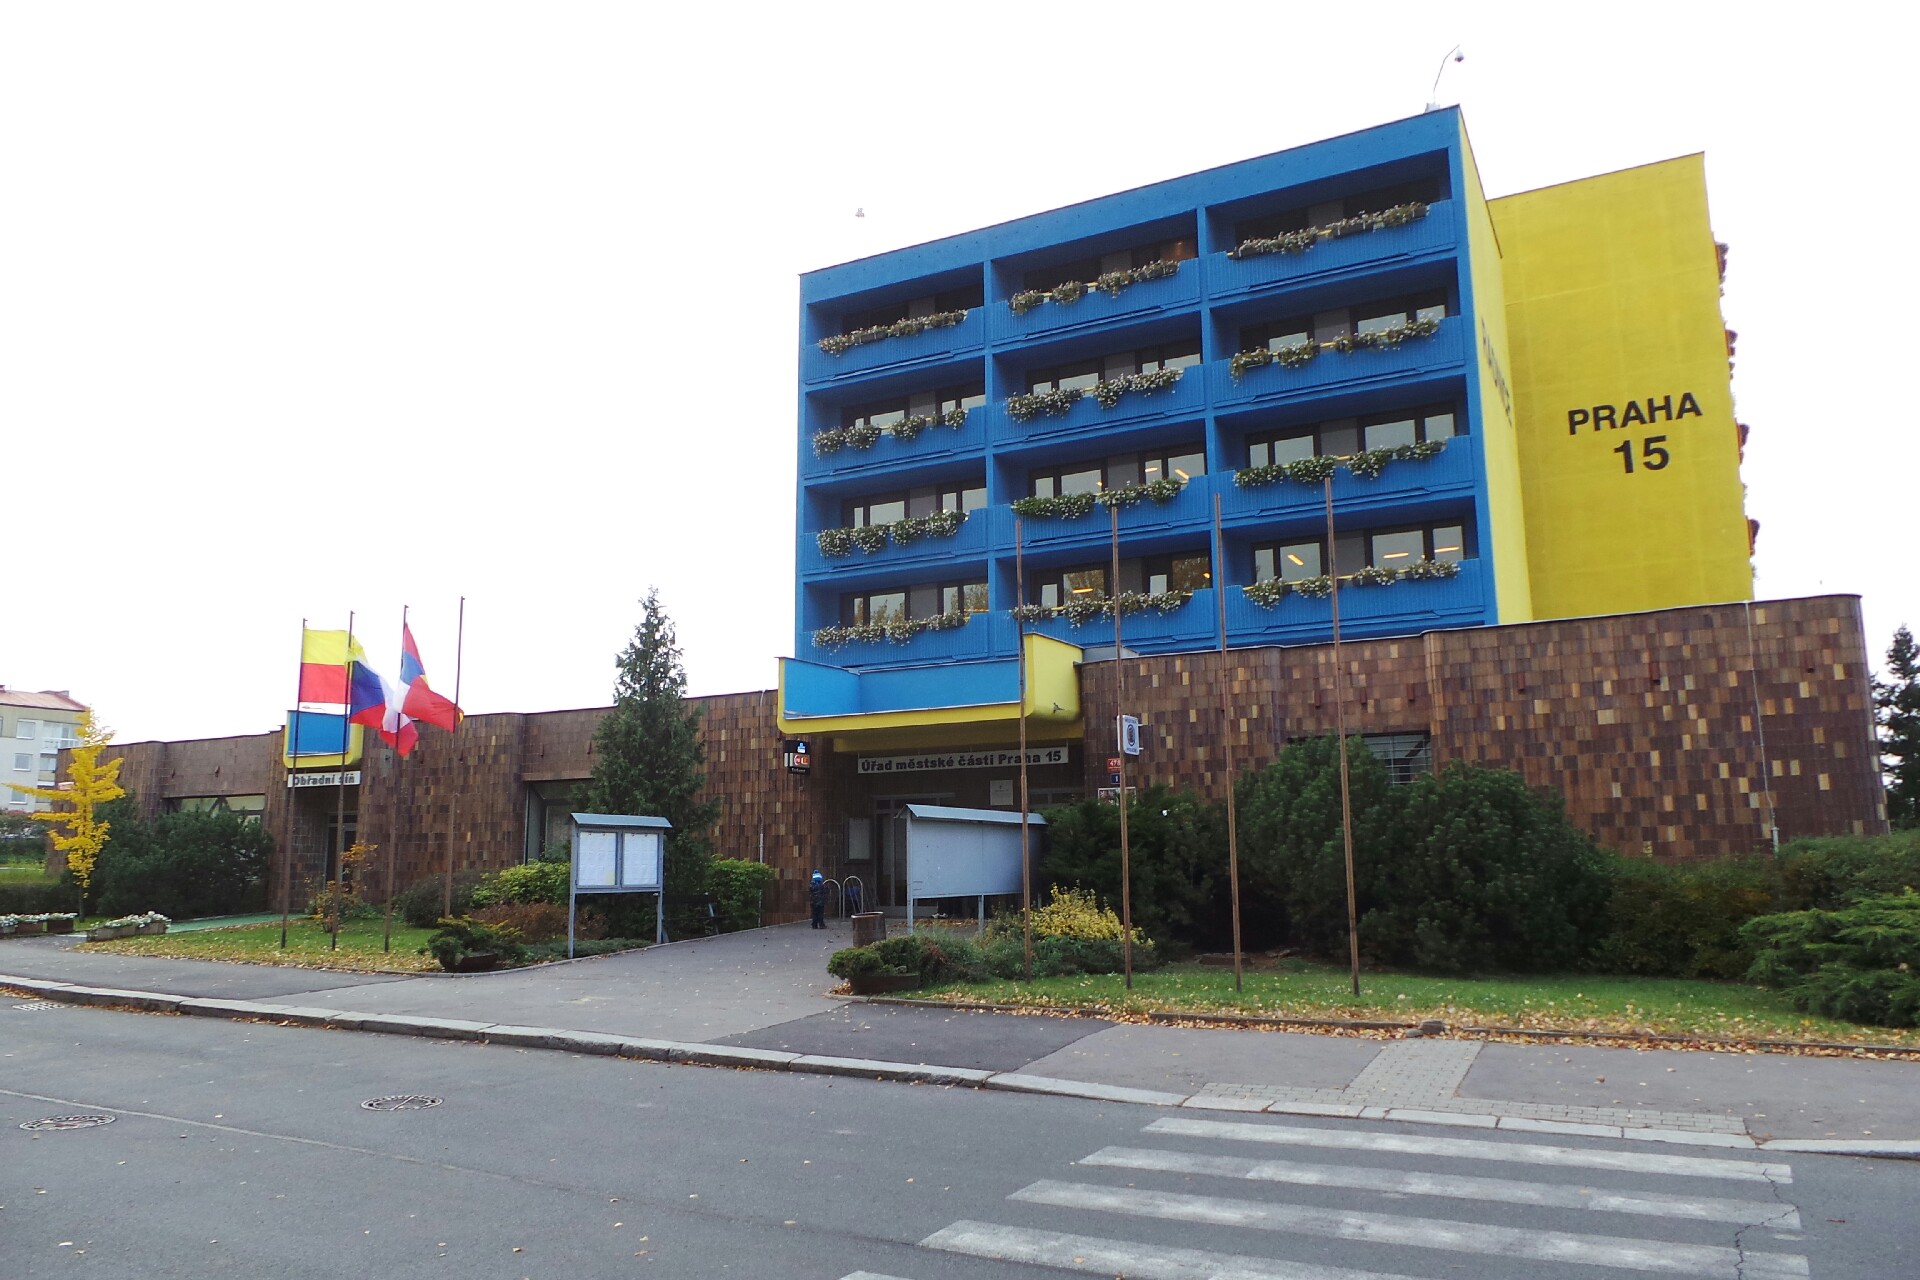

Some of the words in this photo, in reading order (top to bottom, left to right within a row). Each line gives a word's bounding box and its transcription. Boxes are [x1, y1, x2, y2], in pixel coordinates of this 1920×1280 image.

[1568, 392, 1703, 435] PRAHA
[1613, 435, 1669, 474] 15
[861, 759, 893, 772] Úřad
[896, 756, 955, 771] městské
[958, 754, 994, 767] části
[998, 752, 1041, 765] Praha
[1045, 750, 1062, 762] 15
